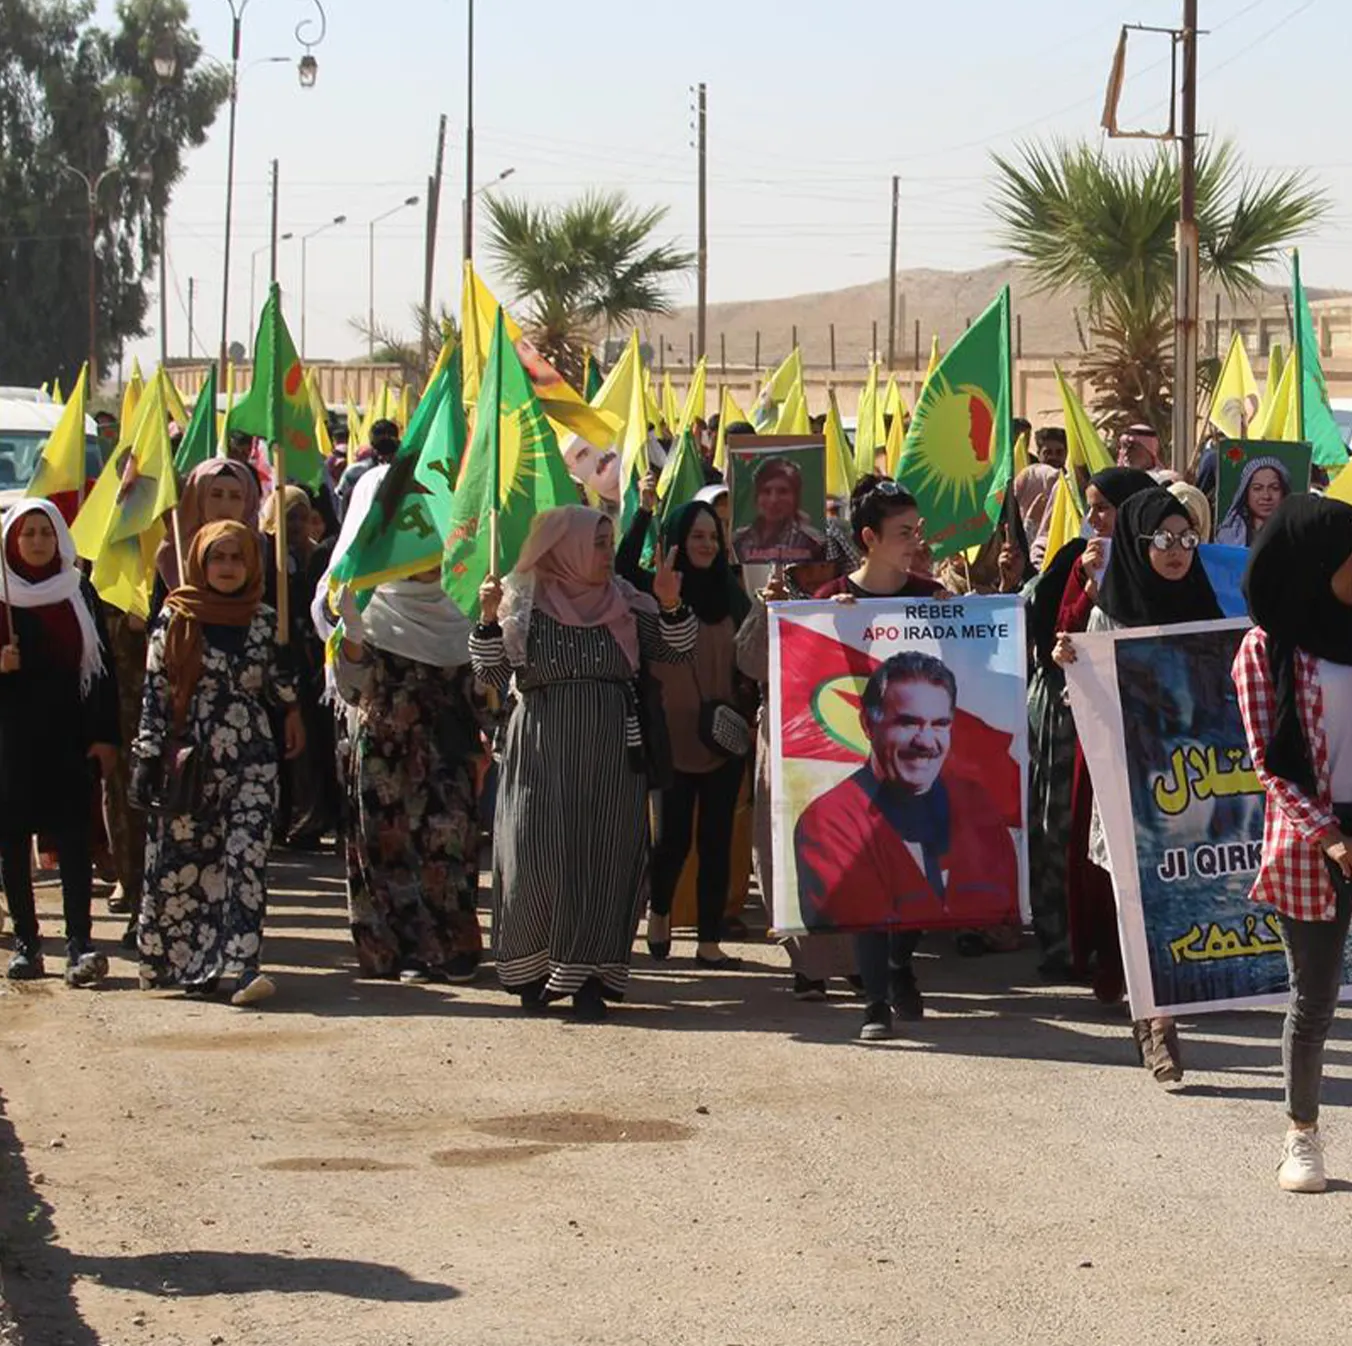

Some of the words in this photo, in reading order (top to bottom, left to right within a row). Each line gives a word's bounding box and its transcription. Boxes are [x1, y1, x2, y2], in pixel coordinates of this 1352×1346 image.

[905, 604, 964, 619] RÊBER
[862, 627, 899, 641] APO
[903, 626, 957, 640] IRADA
[961, 624, 1009, 639] MEYE
[1153, 746, 1267, 816] تلال
[1158, 848, 1190, 882] JI
[1194, 841, 1264, 880] QIRK
